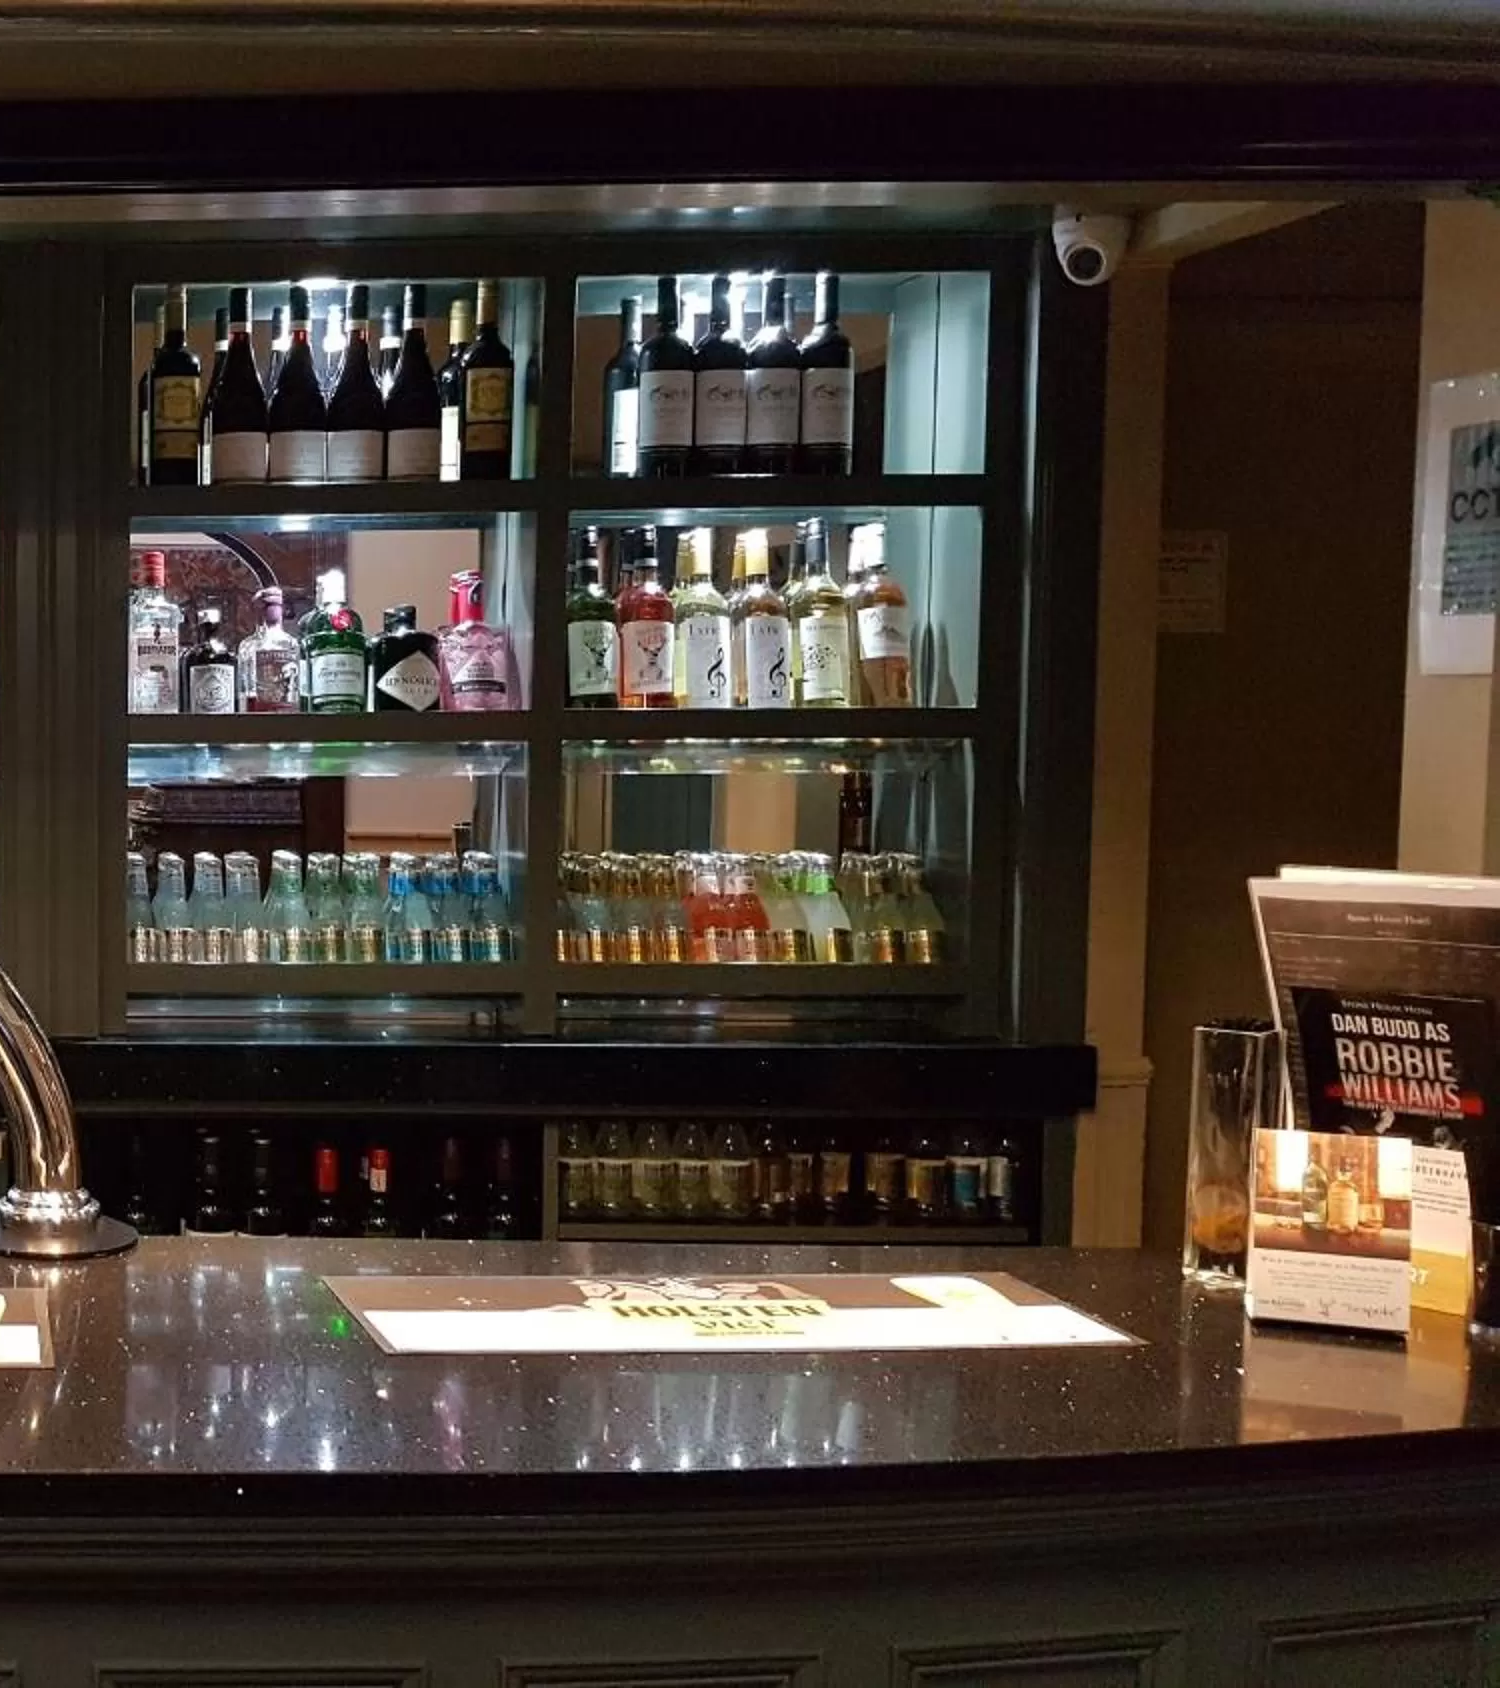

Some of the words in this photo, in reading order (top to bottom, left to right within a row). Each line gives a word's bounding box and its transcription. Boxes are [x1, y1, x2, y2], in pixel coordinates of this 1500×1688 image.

[1332, 1013, 1369, 1034] DAN
[1372, 1017, 1420, 1040] BUDD
[1424, 1023, 1451, 1043] AS
[1336, 1037, 1457, 1083] ROBBIE
[1340, 1071, 1461, 1112] WILLIAMS
[611, 1304, 826, 1318] HOLSTEN
